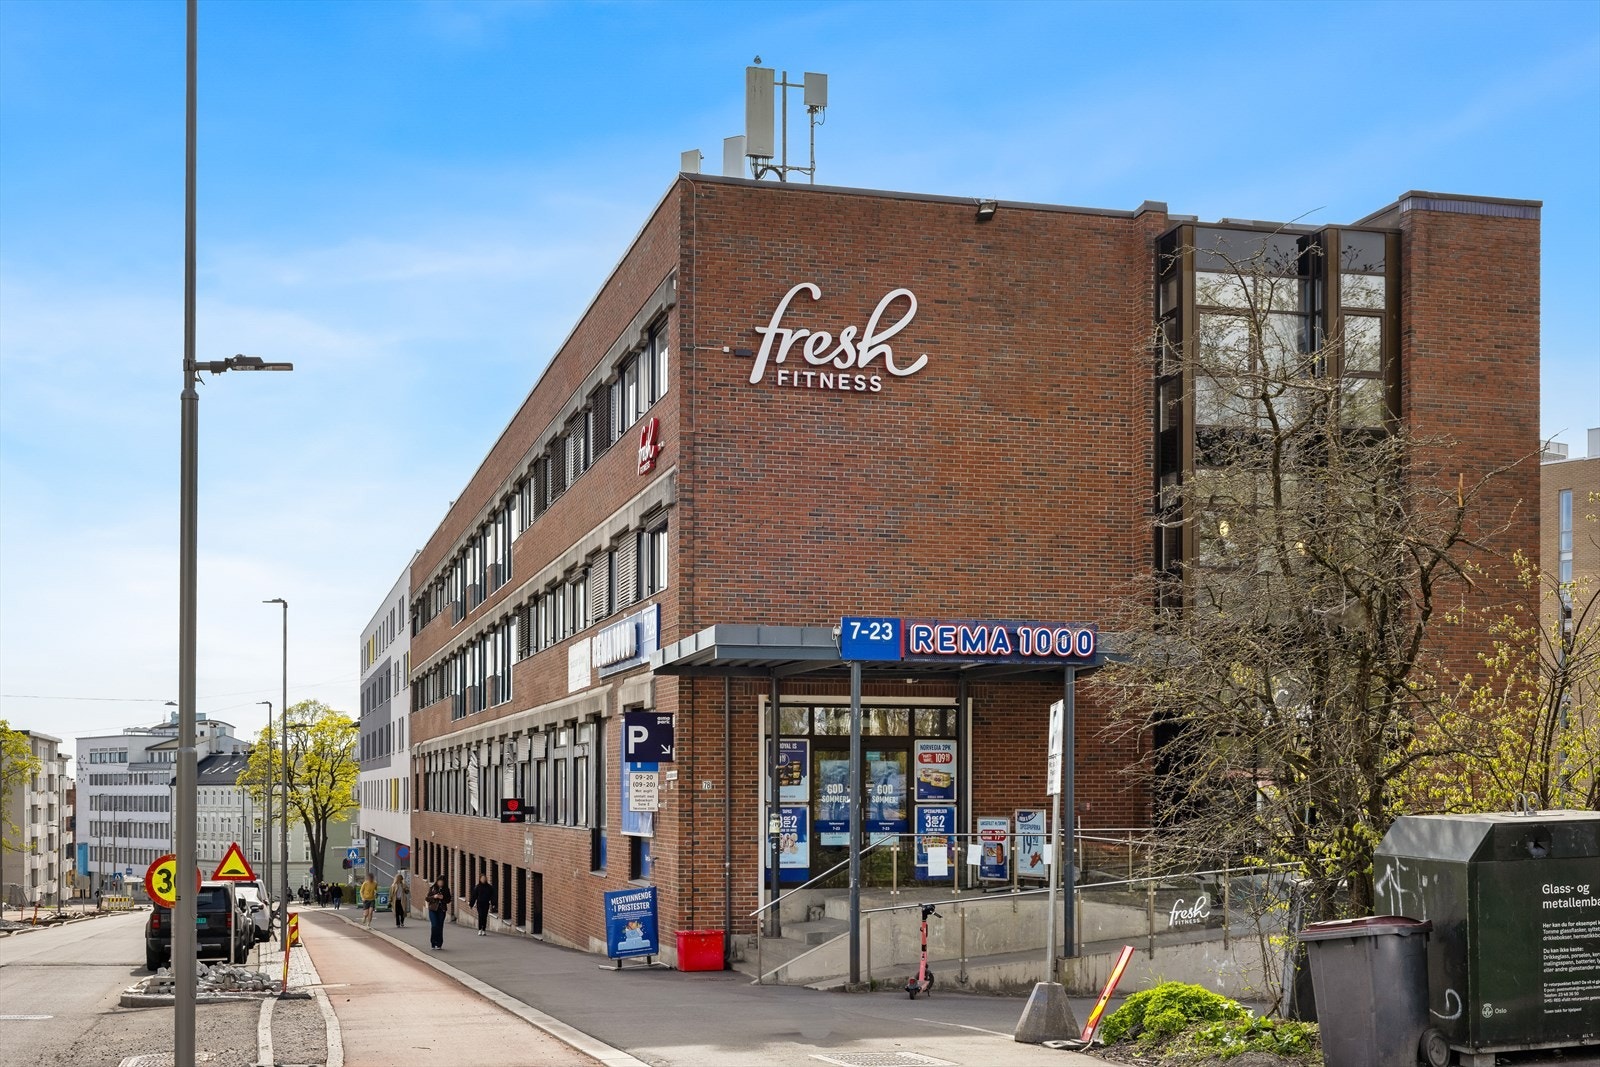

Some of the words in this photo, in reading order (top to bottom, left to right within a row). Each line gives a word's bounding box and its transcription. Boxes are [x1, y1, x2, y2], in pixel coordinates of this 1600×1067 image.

[749, 282, 928, 384] fresh
[777, 369, 882, 392] FITNESS
[850, 621, 893, 640] 7-23
[910, 624, 1014, 657] REMA
[1016, 625, 1096, 658] 1000
[628, 725, 649, 754] P
[935, 753, 946, 763] 109
[703, 781, 711, 789] 78
[827, 784, 844, 794] GOD
[877, 784, 894, 794] GOD
[822, 795, 849, 803] SOMMER!
[872, 795, 898, 804] SOMMER!
[783, 815, 791, 828] FOR
[791, 815, 798, 828] 2
[925, 815, 931, 828] 3
[939, 815, 945, 828] 2
[157, 868, 177, 894] 3
[1542, 884, 1575, 895] Glass-
[1577, 884, 1590, 895] og
[611, 891, 652, 906] MESTVINNENDE
[618, 902, 650, 912] PRISTESTER
[1169, 896, 1210, 926] fresh
